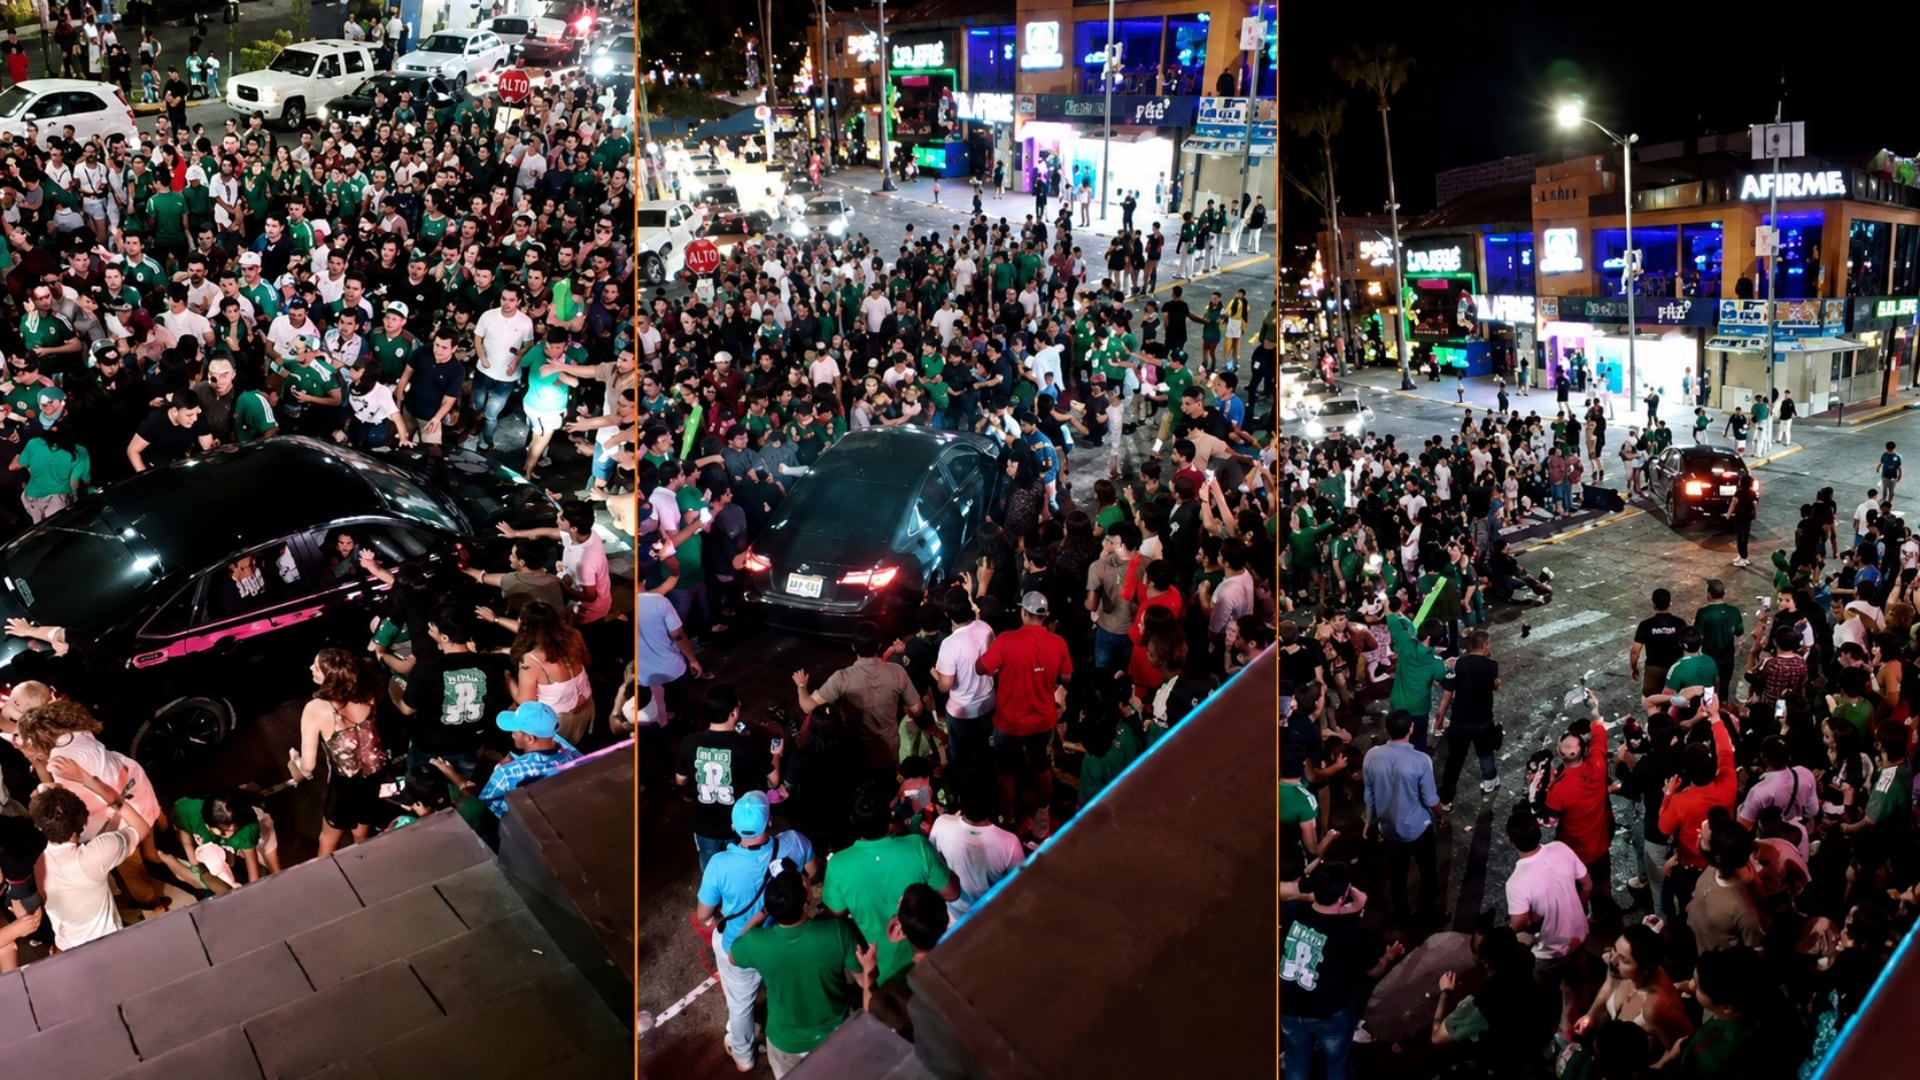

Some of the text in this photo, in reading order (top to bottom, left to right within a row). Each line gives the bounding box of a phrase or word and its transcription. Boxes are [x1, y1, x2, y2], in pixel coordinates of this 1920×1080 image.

[499, 78, 528, 94] ALTO
[1740, 170, 1844, 200] AFIRME
[689, 249, 717, 265] ALTO
